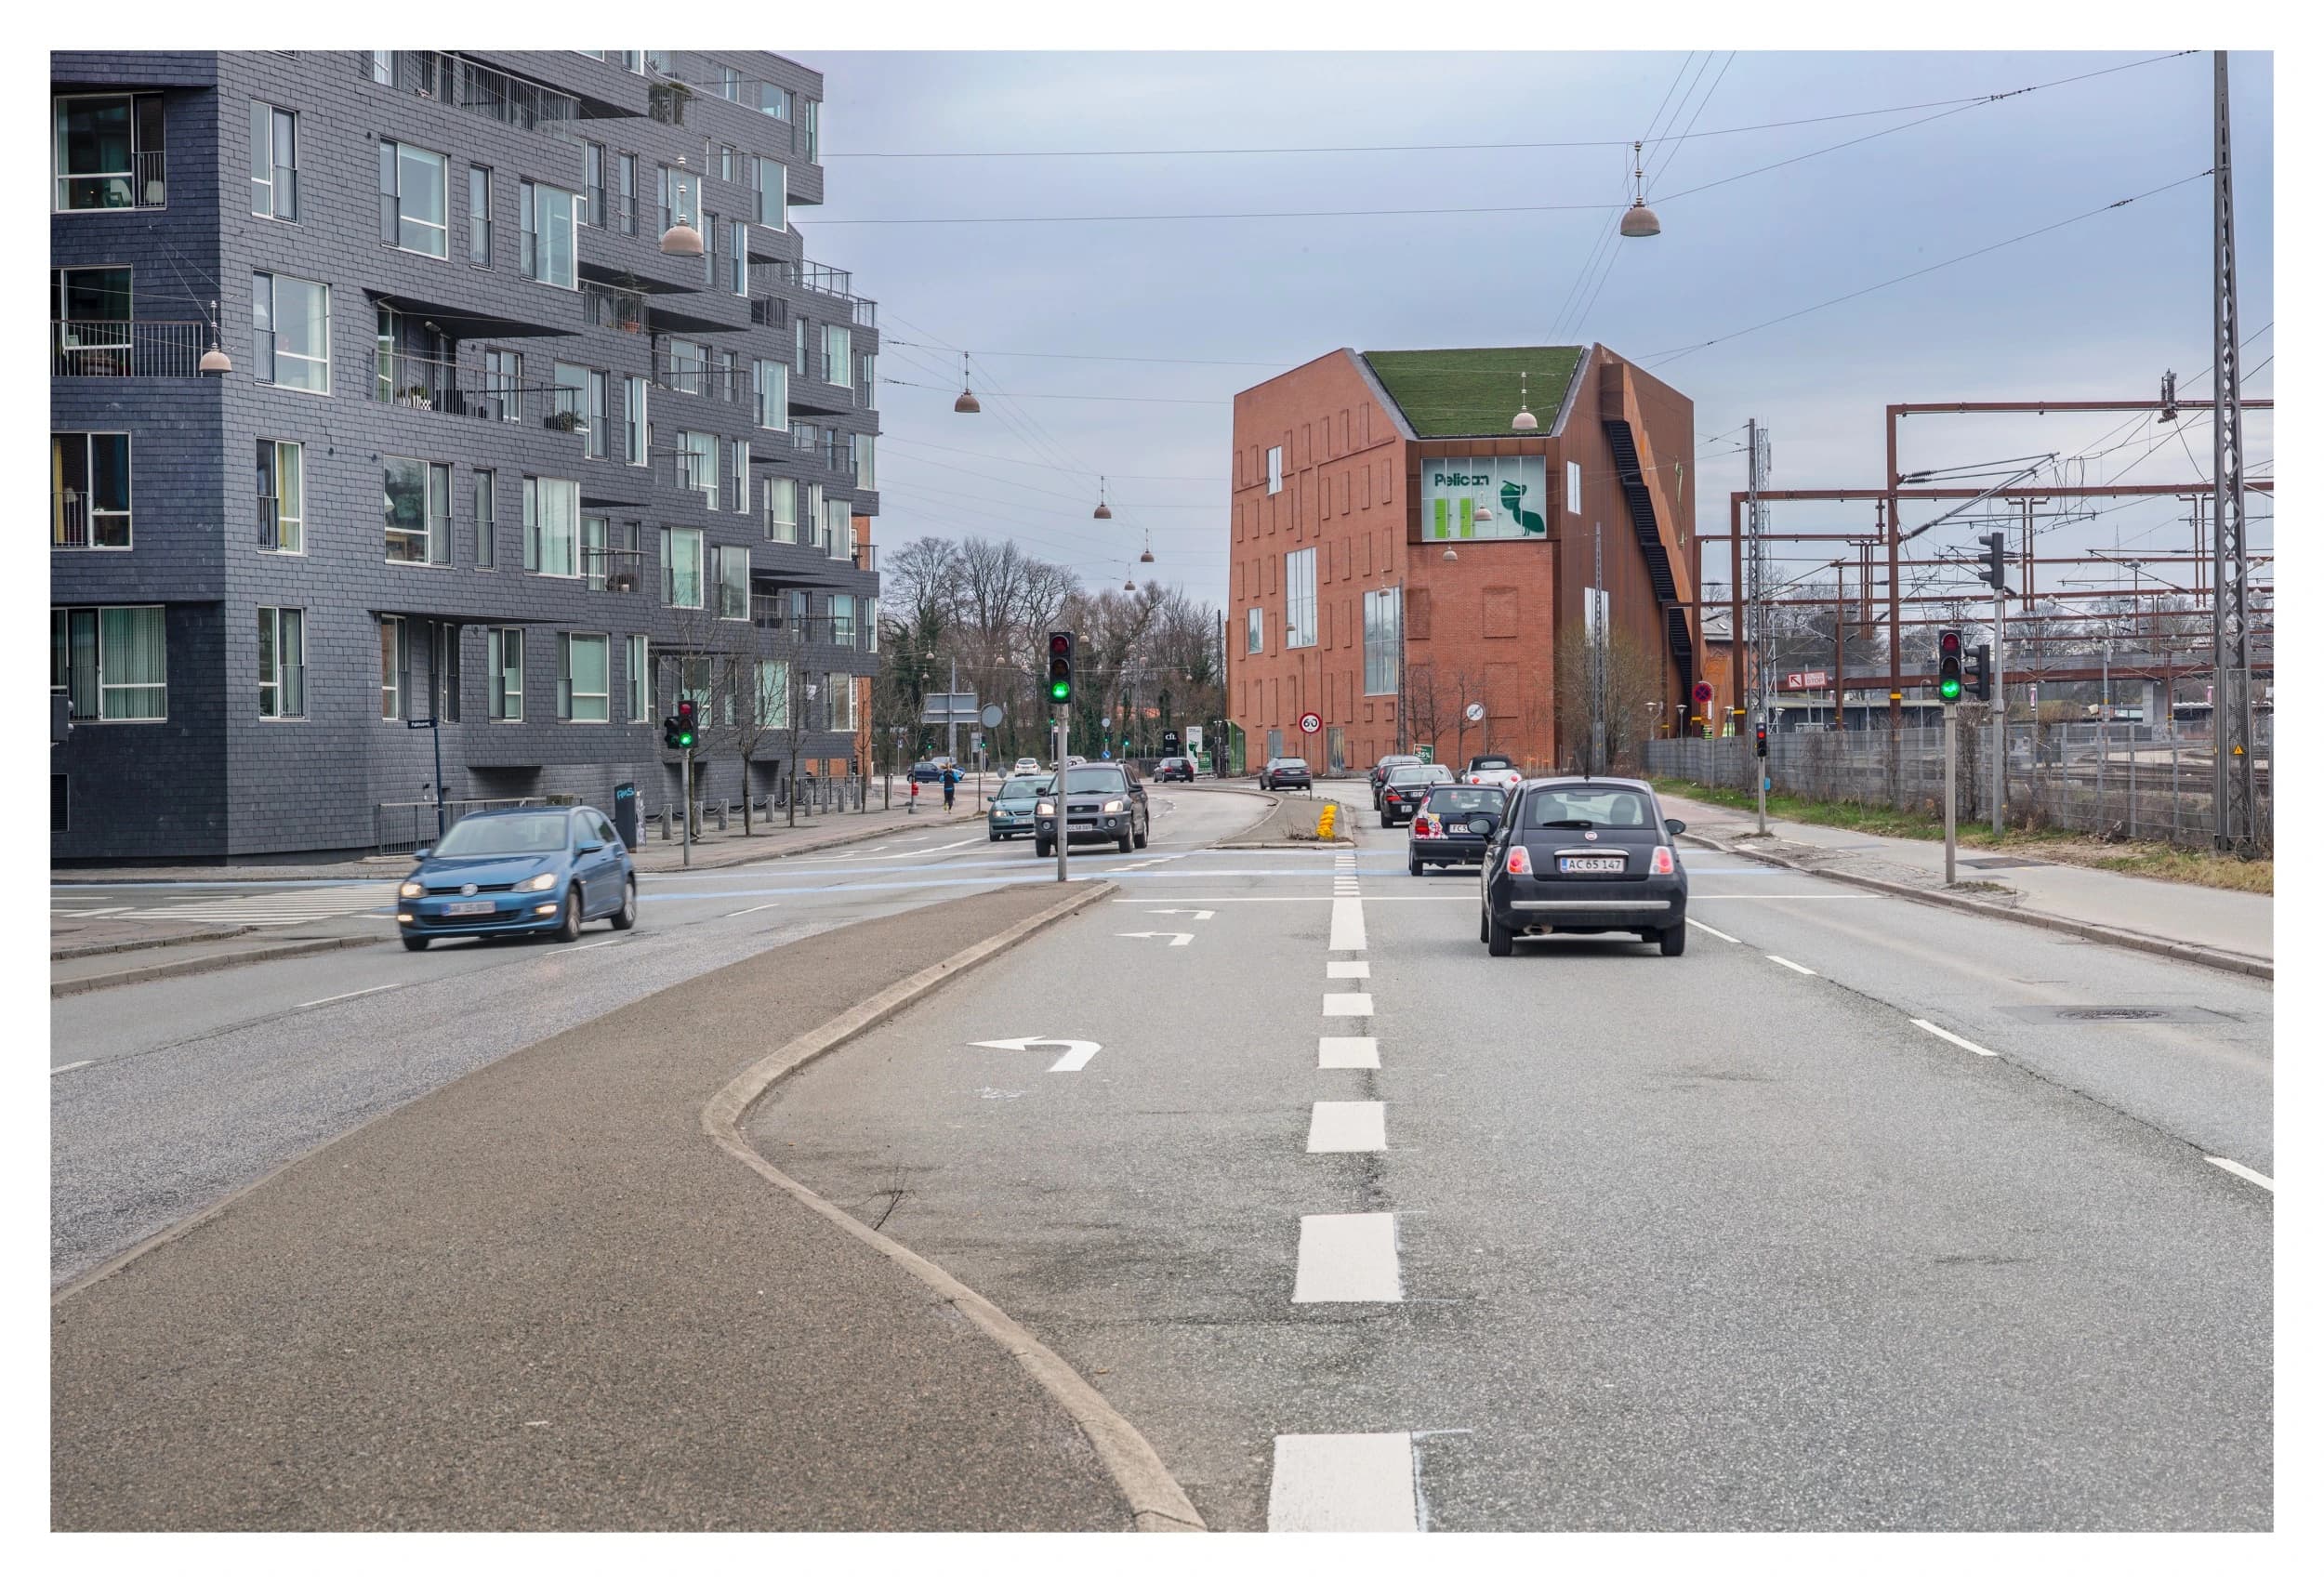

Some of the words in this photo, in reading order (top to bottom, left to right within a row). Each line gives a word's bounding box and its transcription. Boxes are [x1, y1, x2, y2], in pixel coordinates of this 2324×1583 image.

[1434, 472, 1489, 487] Pelican
[1303, 718, 1318, 728] 60
[1569, 860, 1584, 869] AC
[1586, 860, 1599, 869] 65
[1603, 860, 1621, 869] 147
